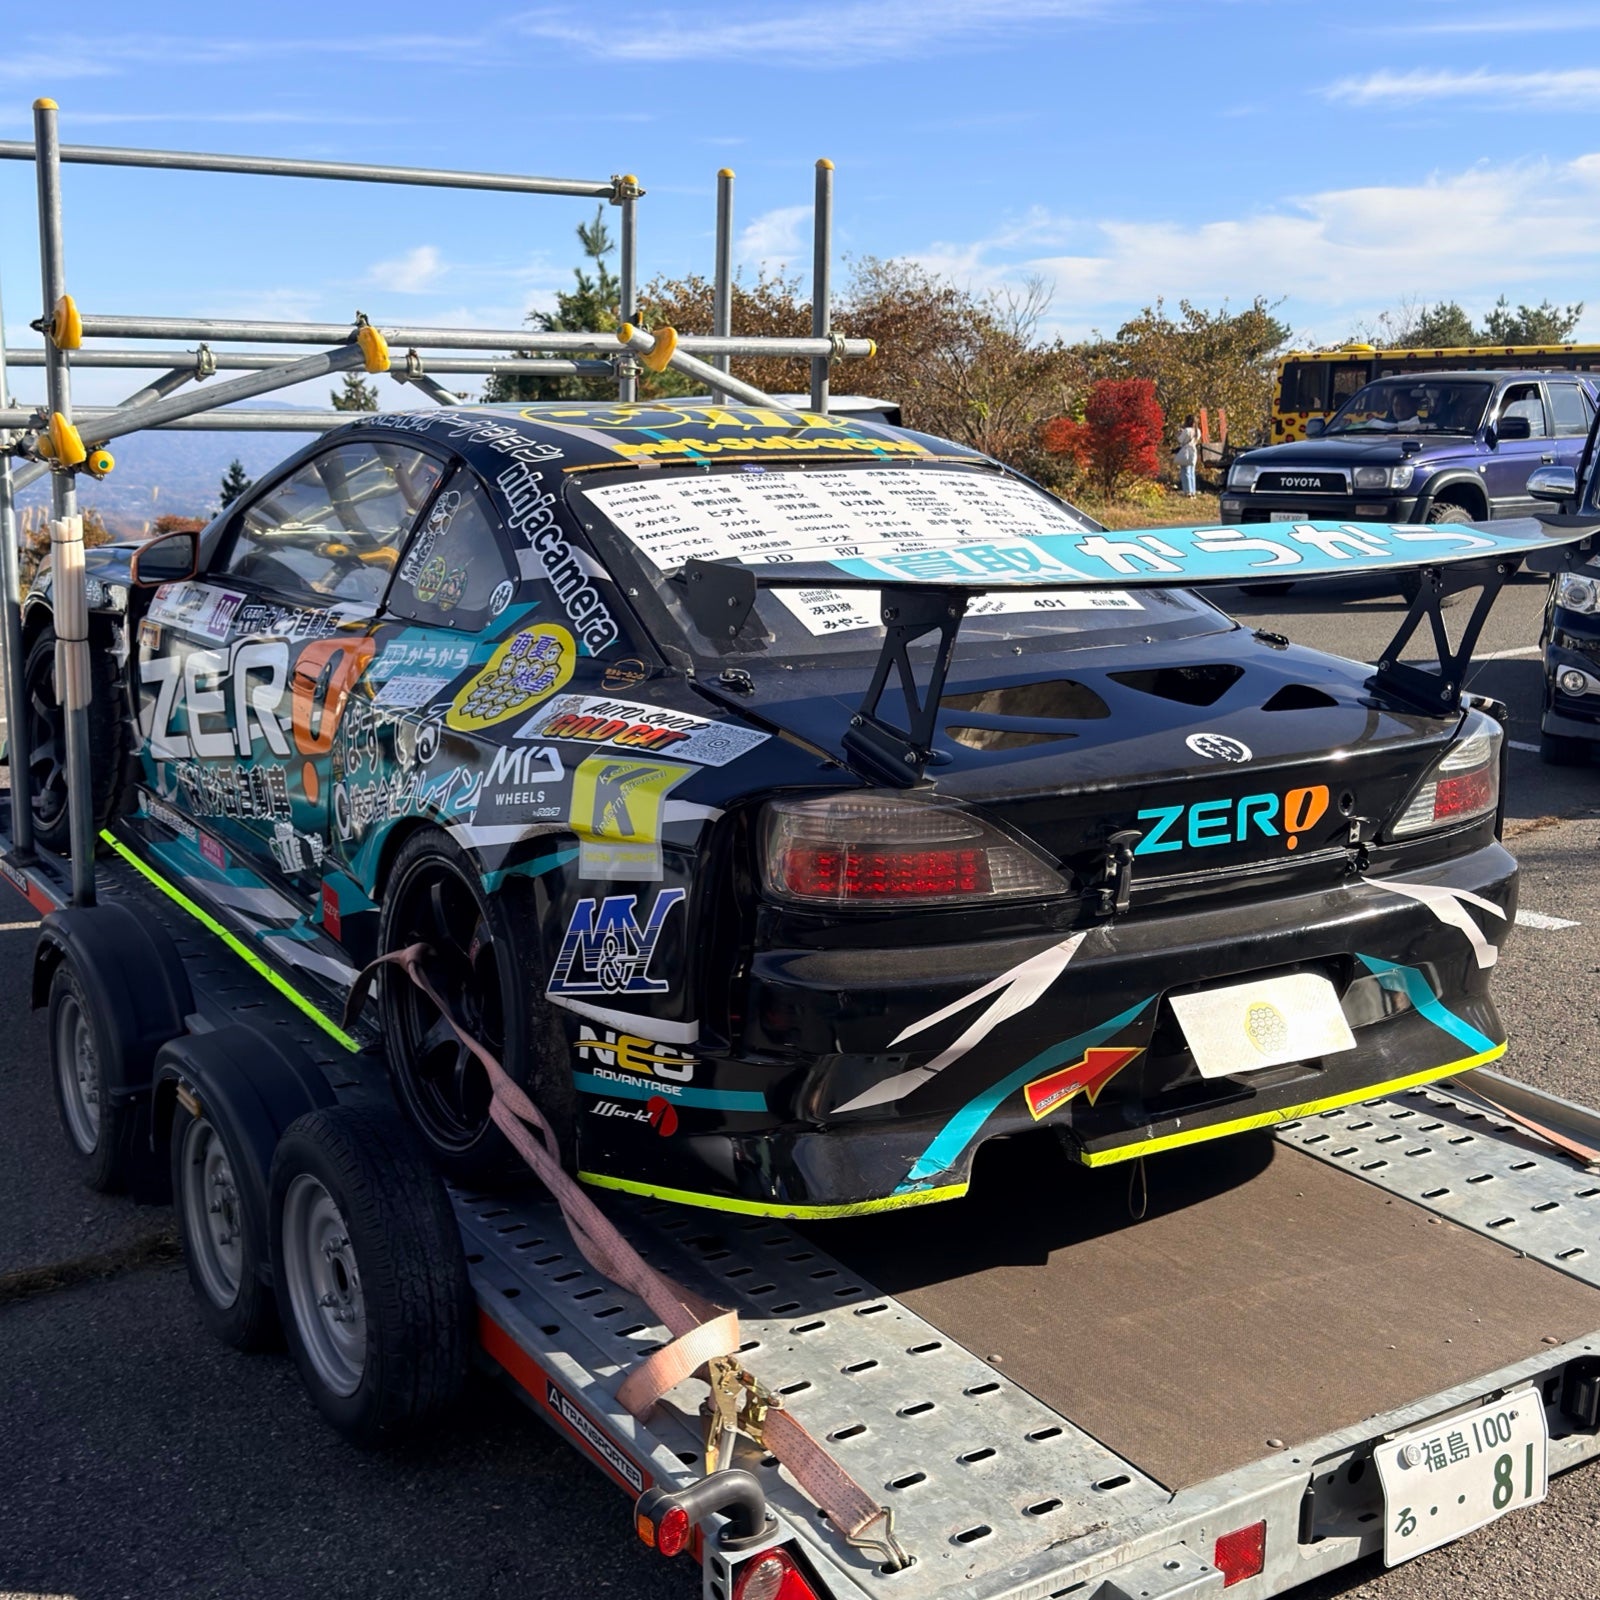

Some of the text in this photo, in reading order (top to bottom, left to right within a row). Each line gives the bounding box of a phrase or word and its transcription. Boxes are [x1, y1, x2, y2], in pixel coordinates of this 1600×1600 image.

[612, 436, 928, 458] mitsubachi
[1280, 477, 1321, 488] TOYOTA
[840, 499, 886, 508] U-TAN
[786, 512, 833, 522] SACHIKO
[637, 525, 700, 541] TAKATOMO
[496, 461, 619, 658] ninjacamera
[764, 553, 794, 563] DD
[835, 546, 865, 557] RIZ
[1074, 524, 1498, 574] かうかう
[878, 544, 1062, 579] 買取
[801, 593, 843, 604] SHIBUYA
[1034, 599, 1067, 608] 401
[210, 599, 238, 633] 104
[823, 615, 869, 629] みやこ
[404, 647, 469, 669] かうかう
[582, 701, 711, 731] AUTO SHOP
[541, 713, 692, 750] GOLD CAT
[482, 745, 566, 787] MID
[495, 790, 546, 806] WHEELS
[574, 1024, 700, 1083] NEO
[592, 1067, 683, 1097] ADVANTAGE
[1421, 1412, 1512, 1472] 福島 100
[1394, 1507, 1417, 1537] る
